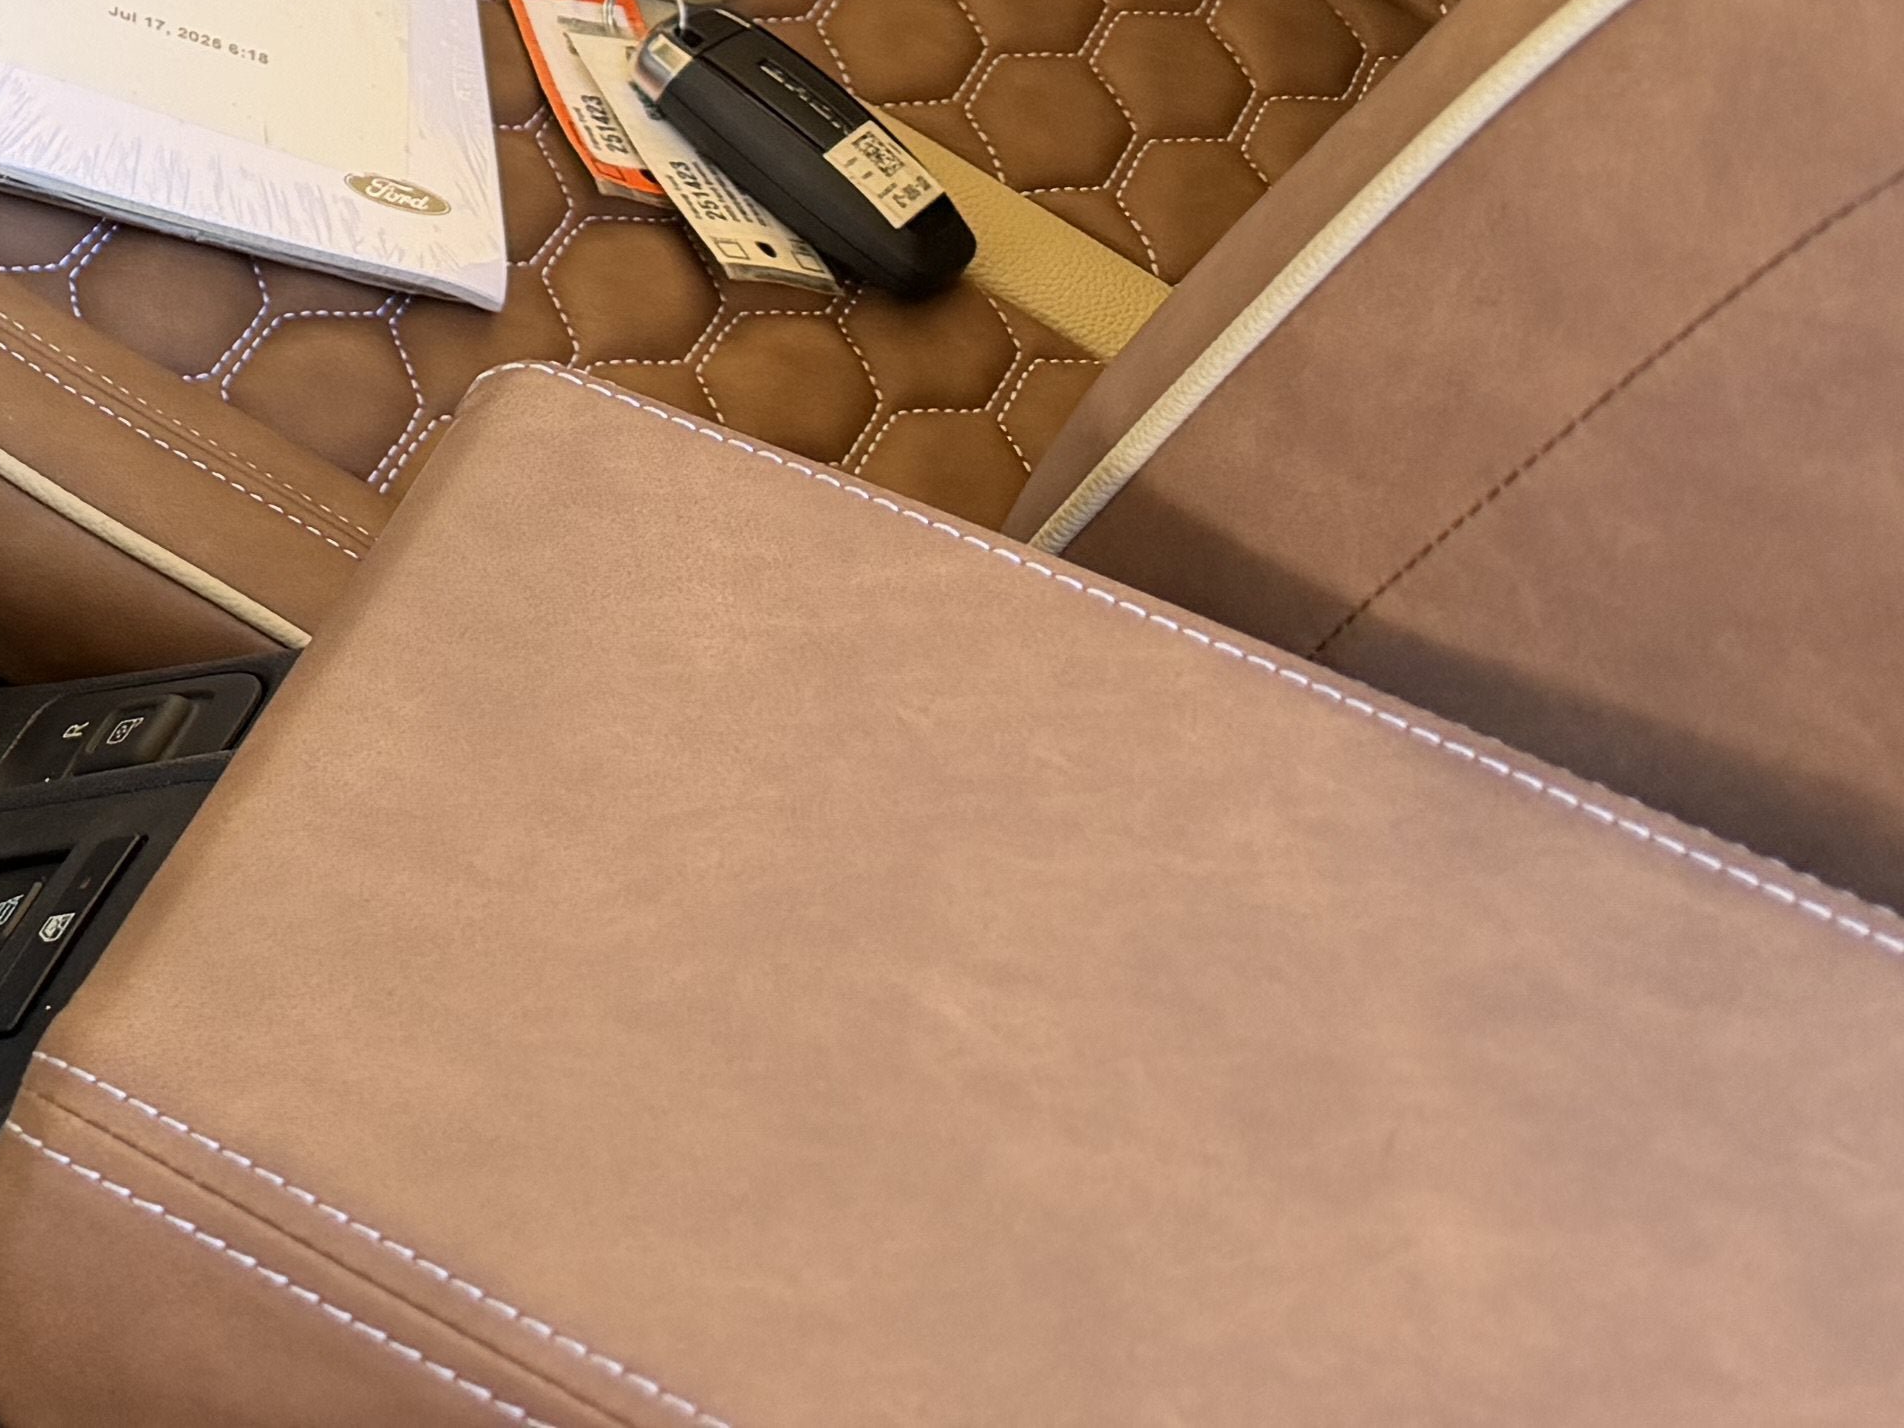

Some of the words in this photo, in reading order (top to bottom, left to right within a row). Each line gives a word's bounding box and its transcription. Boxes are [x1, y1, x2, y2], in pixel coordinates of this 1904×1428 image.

[108, 6, 137, 23] Jul
[144, 16, 171, 36] 17,
[364, 176, 429, 211] Ford
[62, 721, 90, 738] R
